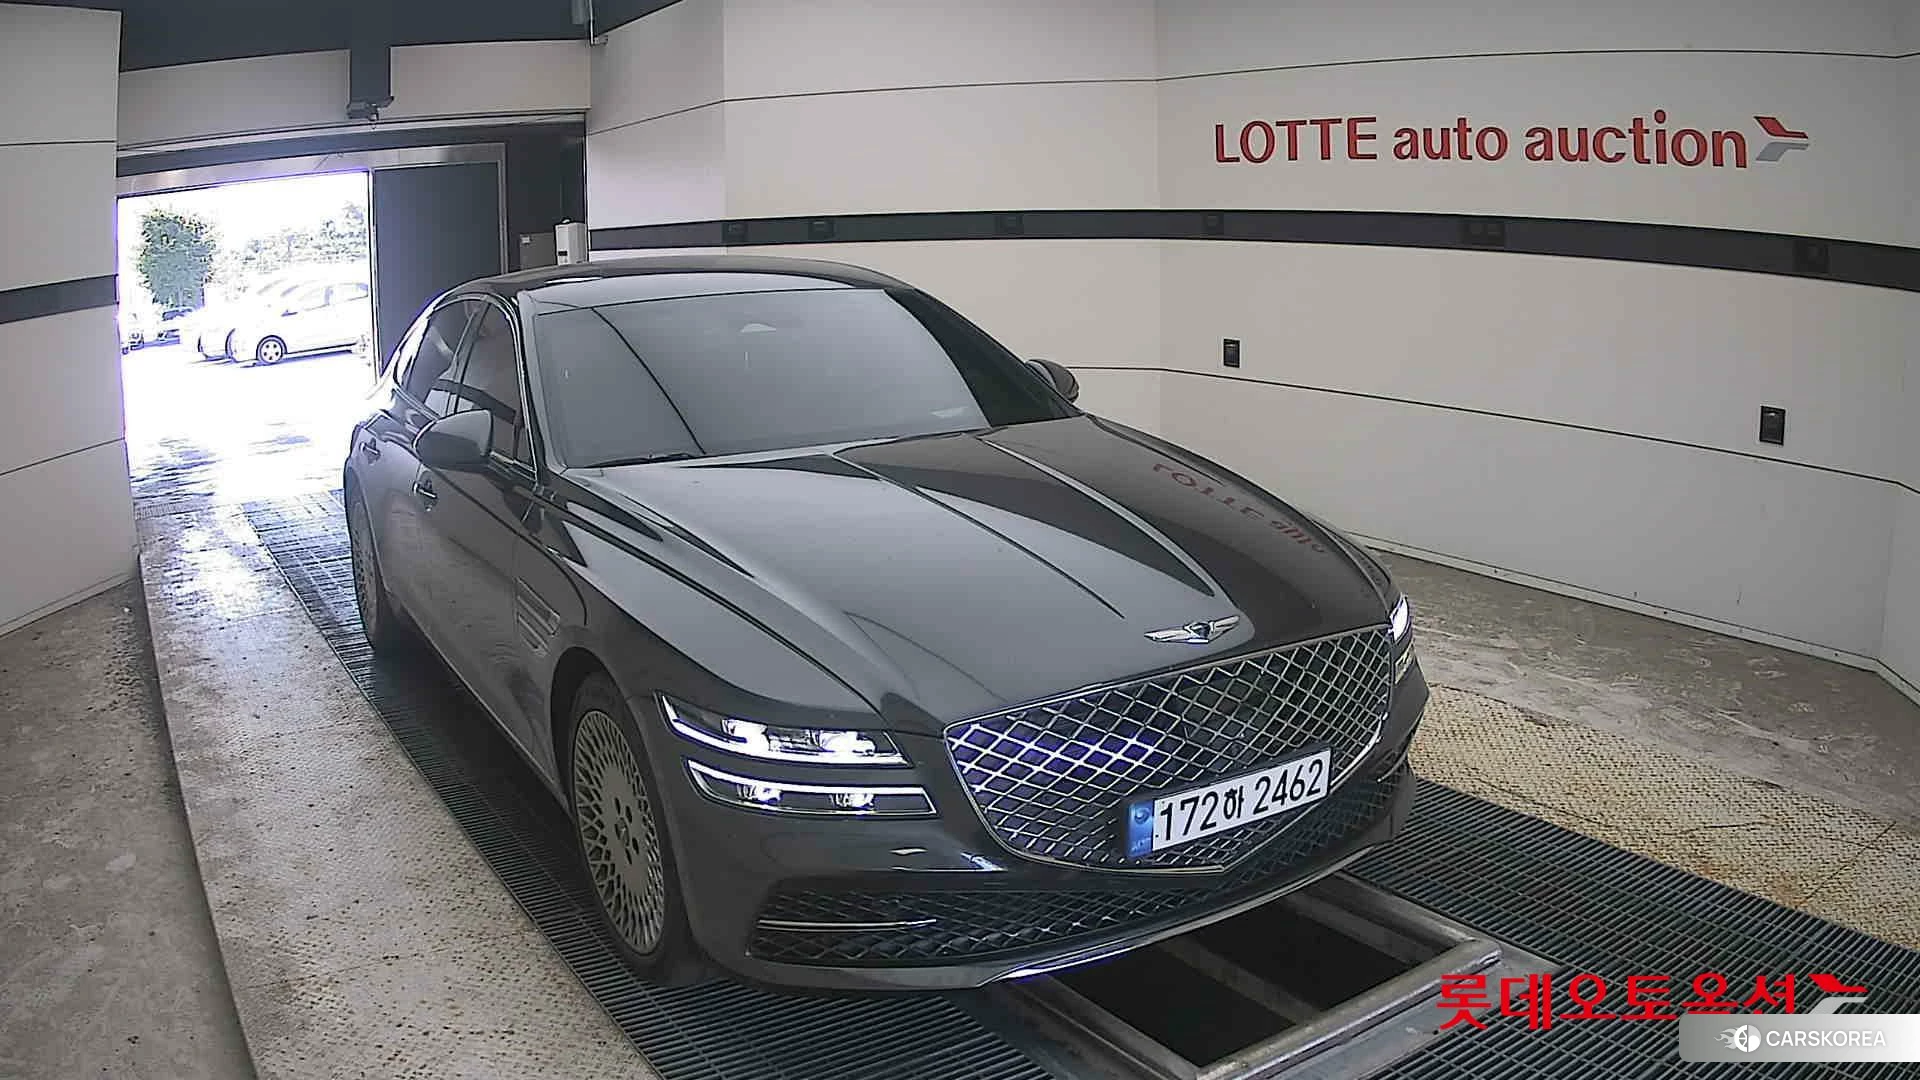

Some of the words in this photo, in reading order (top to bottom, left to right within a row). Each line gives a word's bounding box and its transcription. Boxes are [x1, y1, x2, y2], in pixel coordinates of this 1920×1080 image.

[1214, 116, 1378, 163] LOTTE
[1392, 117, 1509, 161] auto
[1524, 109, 1748, 168] auction
[1160, 785, 1245, 841] 172하
[1252, 758, 1323, 815] 2462
